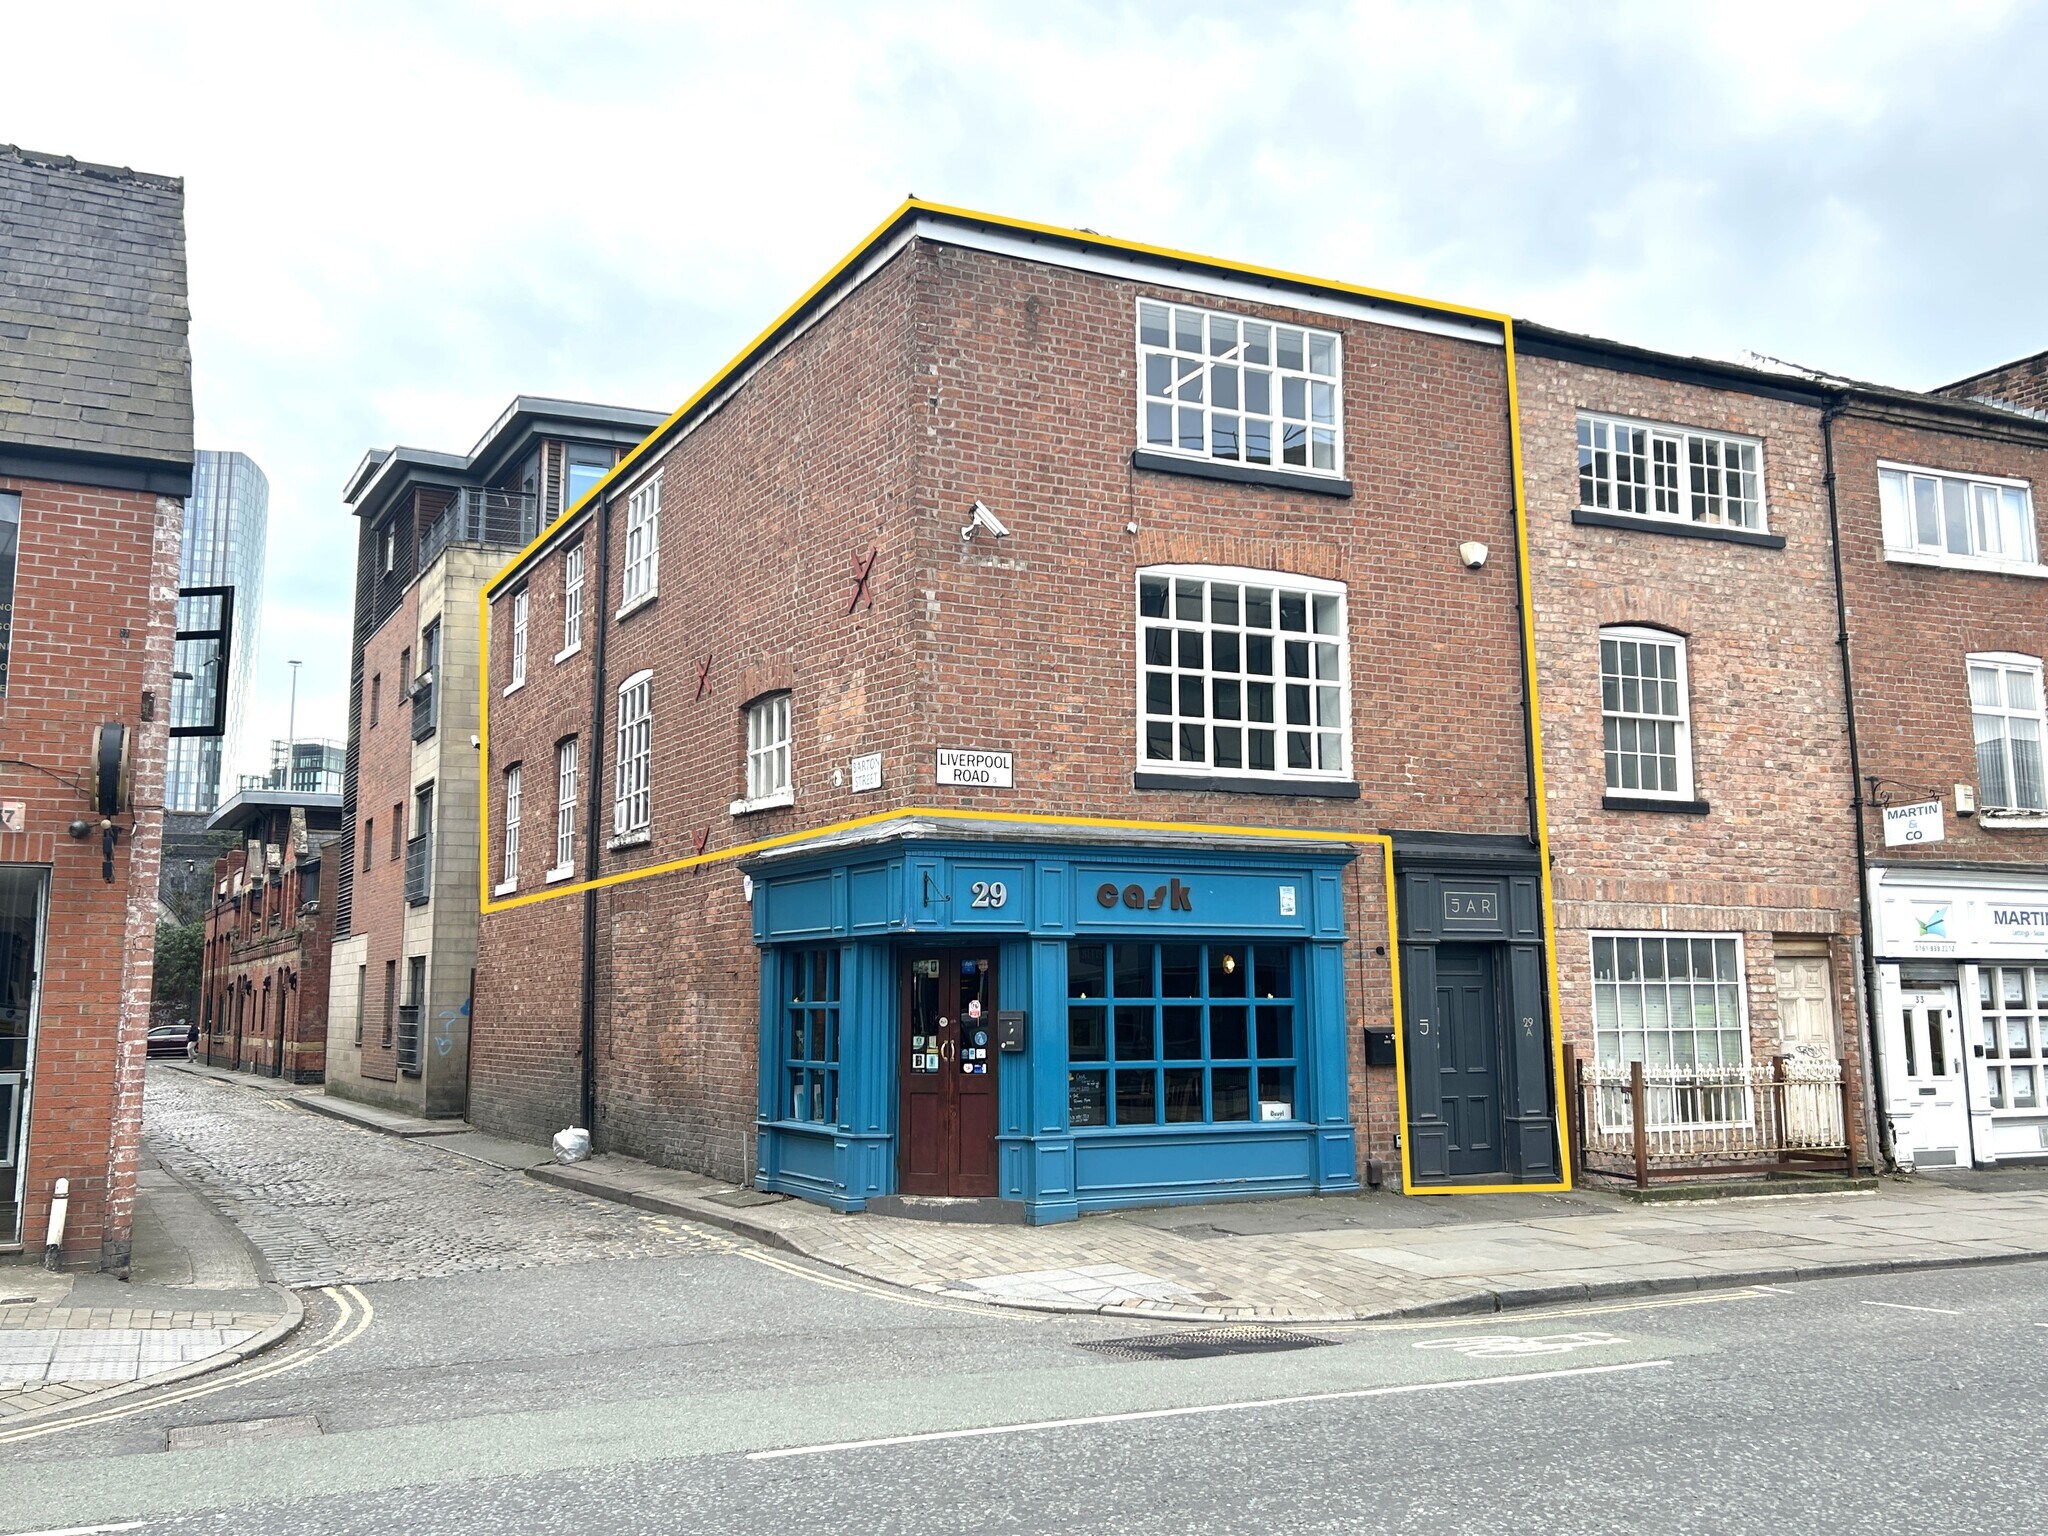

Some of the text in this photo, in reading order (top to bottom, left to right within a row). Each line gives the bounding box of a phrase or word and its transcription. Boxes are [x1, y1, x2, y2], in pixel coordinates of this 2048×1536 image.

[853, 756, 880, 774] BARTON
[940, 753, 1010, 769] LIVERPOOL
[855, 772, 878, 788] STREET
[953, 769, 998, 784] ROAD 3
[1887, 804, 1938, 820] MARTIN
[1908, 819, 1918, 829] &
[1905, 830, 1923, 841] CO
[971, 881, 1008, 908] 29
[1097, 878, 1192, 912] cask
[1915, 995, 1925, 1004] 33
[1522, 1017, 1534, 1028] 29
[1525, 1027, 1533, 1037] A
